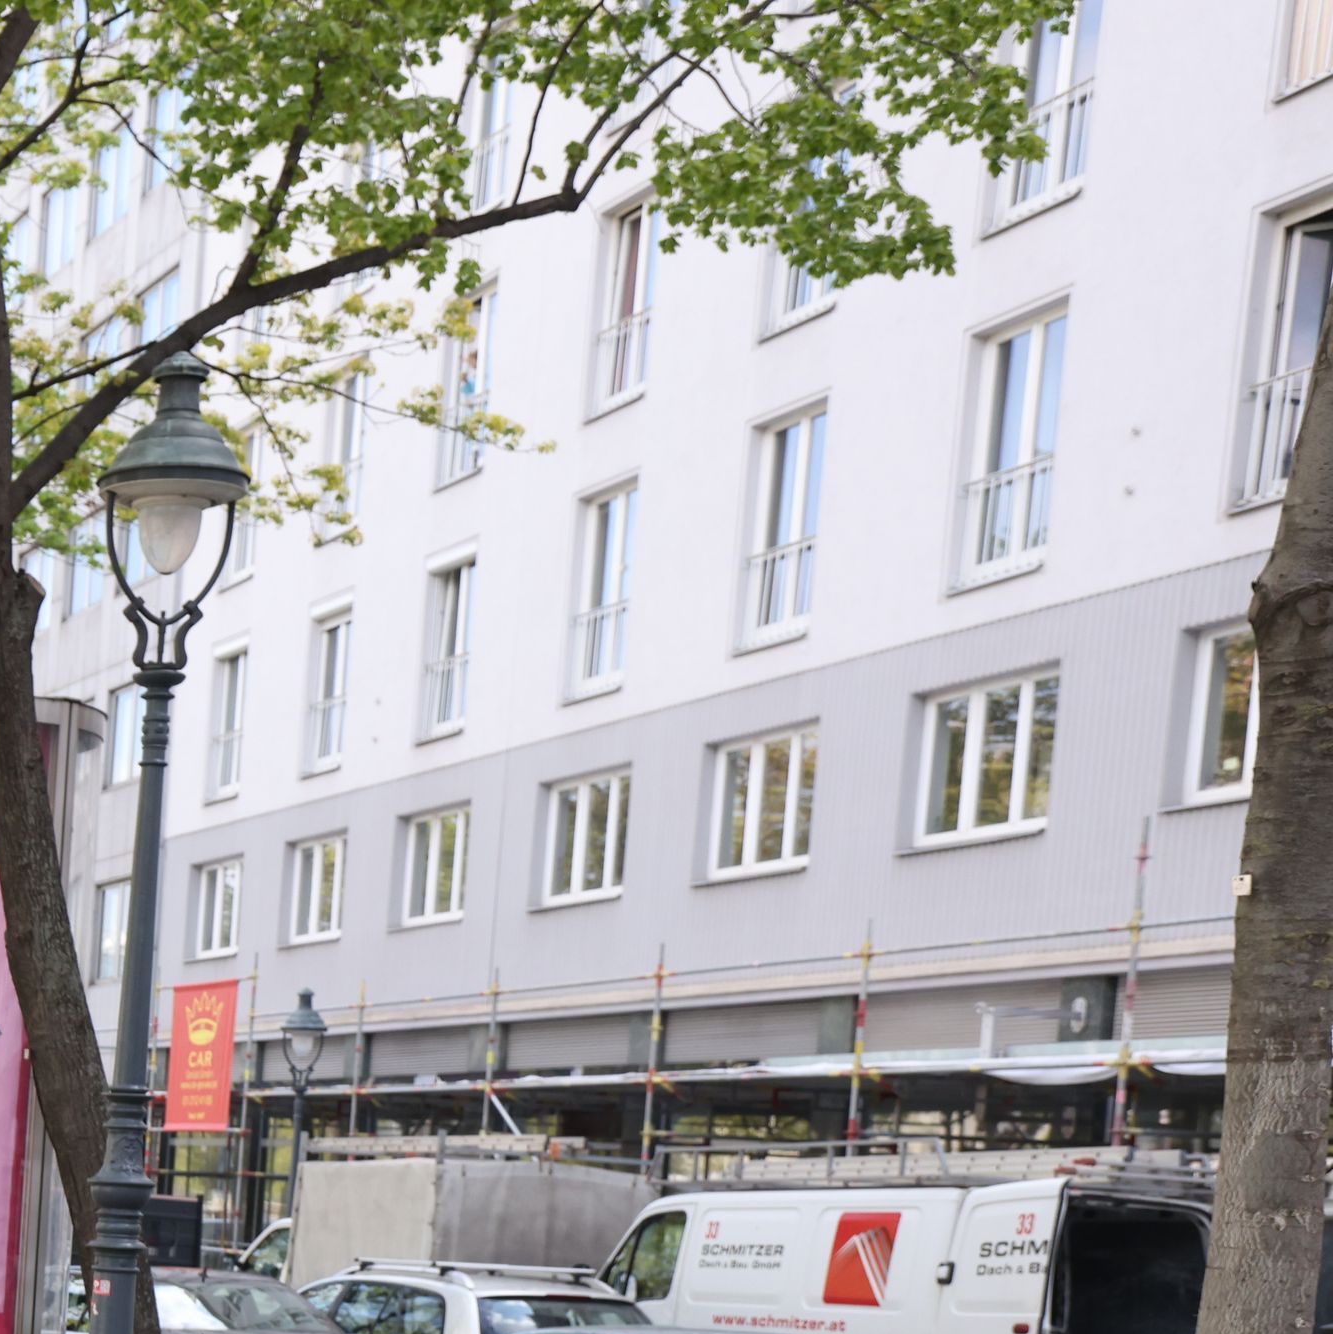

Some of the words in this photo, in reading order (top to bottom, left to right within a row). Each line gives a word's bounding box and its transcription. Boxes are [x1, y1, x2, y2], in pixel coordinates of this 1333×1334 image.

[187, 1050, 213, 1068] CAR
[1016, 1213, 1035, 1235] 33
[701, 1244, 785, 1257] SCHMITZER
[979, 1240, 1049, 1258] SCHM
[976, 1264, 1013, 1276] Dach
[712, 1314, 847, 1332] www.schmitzer.at
